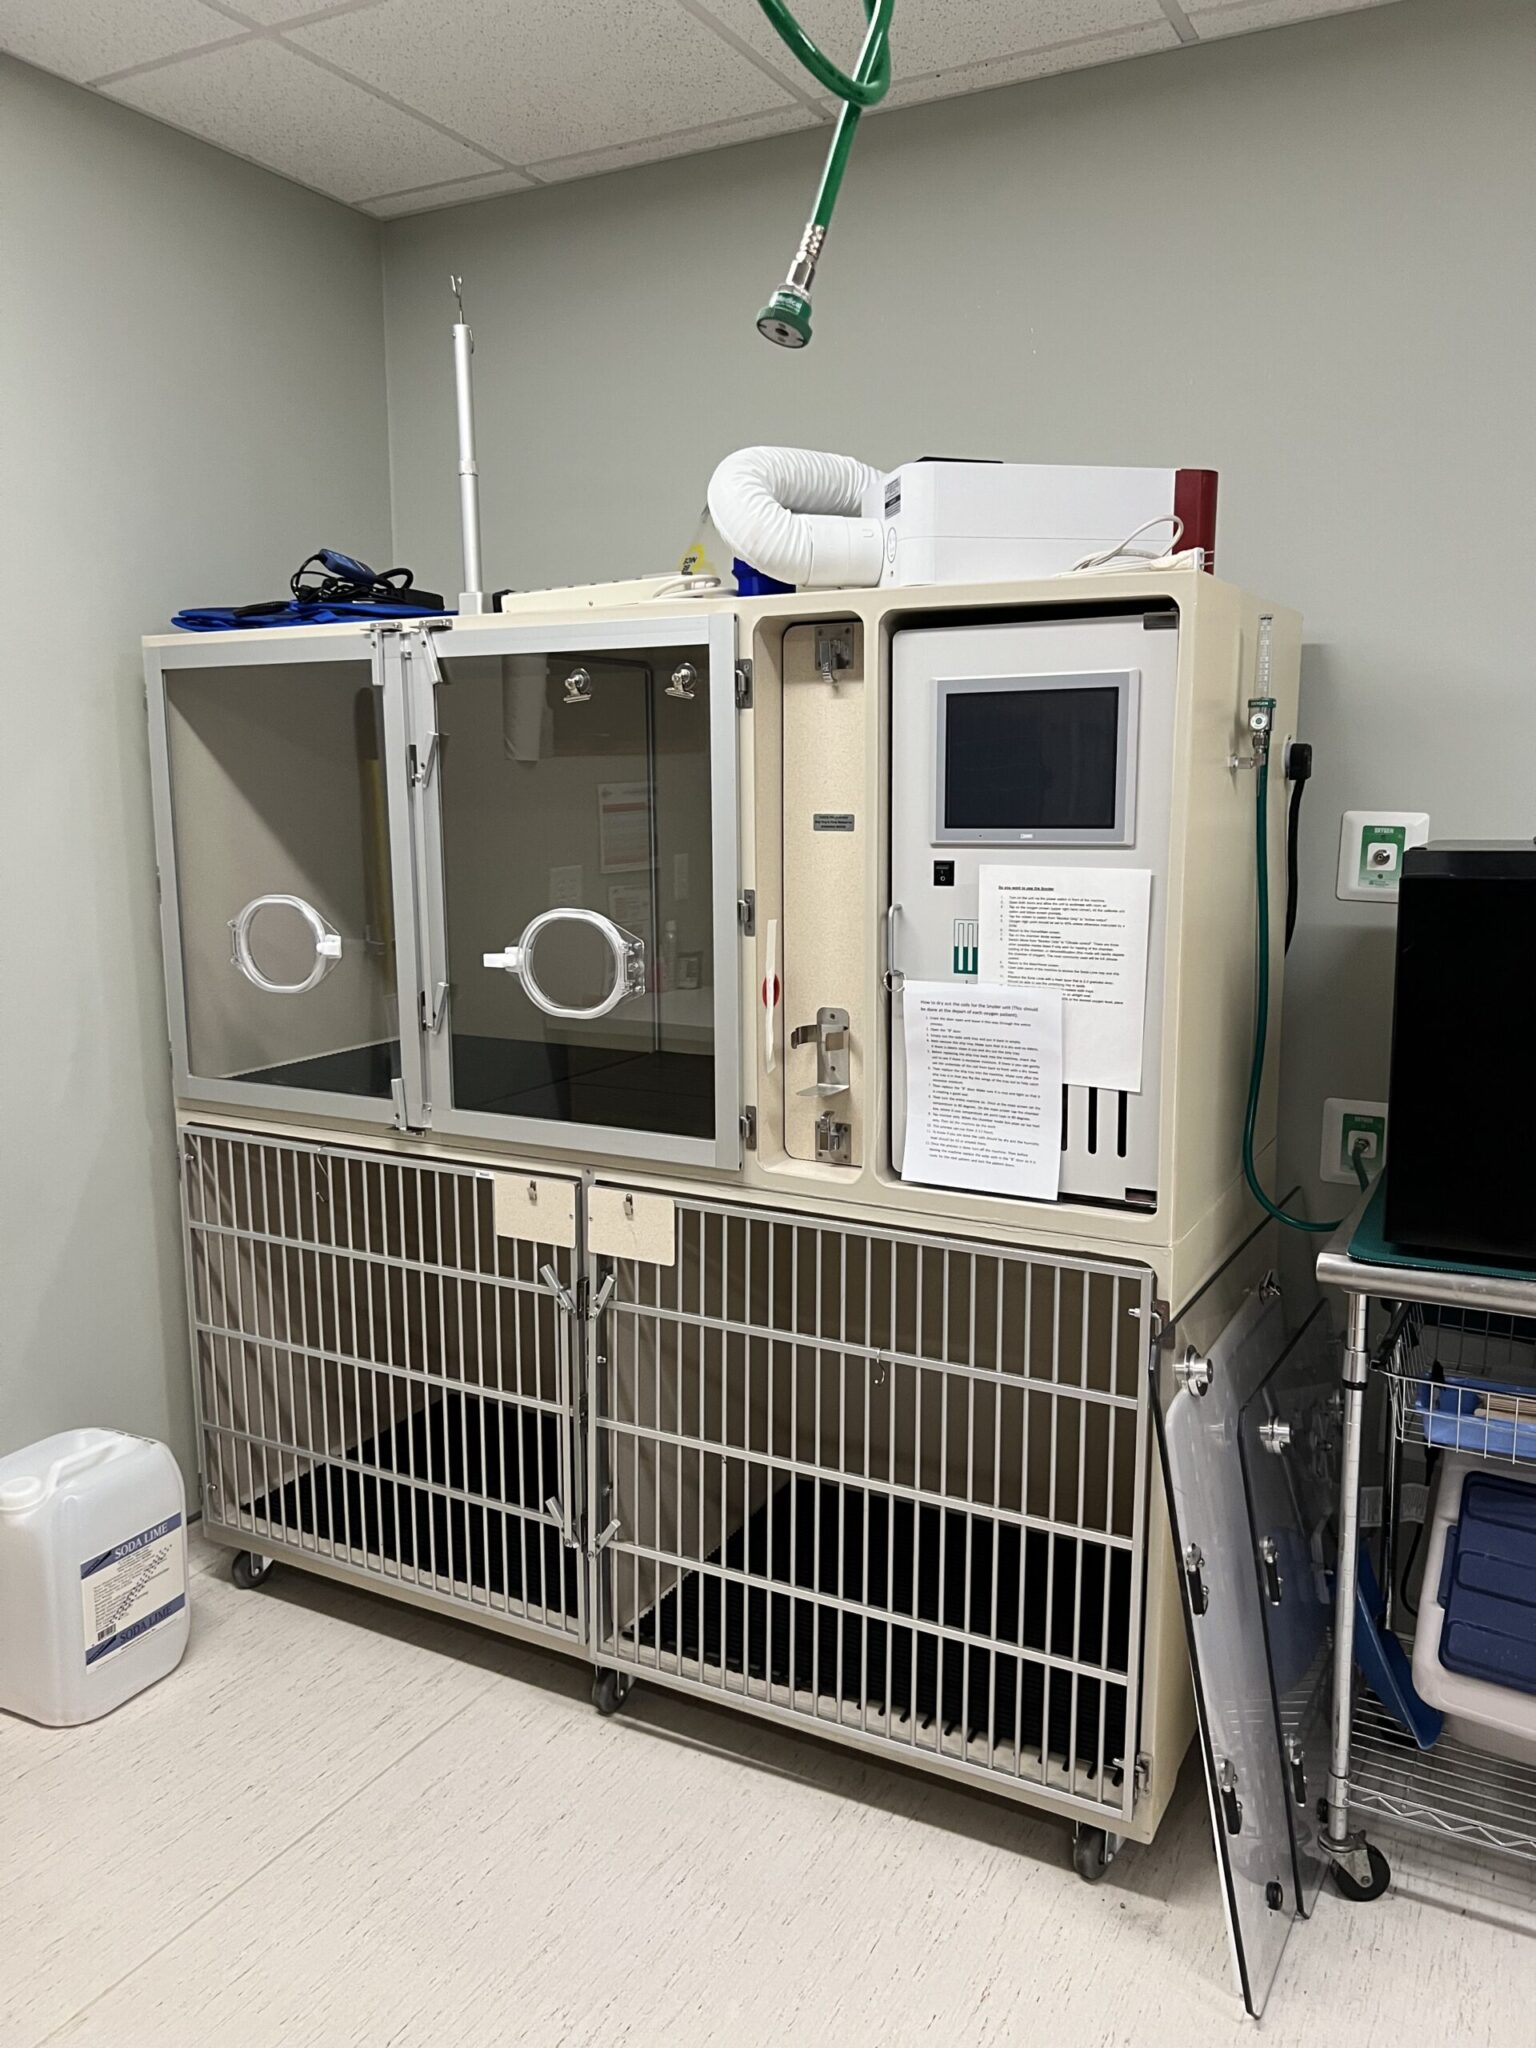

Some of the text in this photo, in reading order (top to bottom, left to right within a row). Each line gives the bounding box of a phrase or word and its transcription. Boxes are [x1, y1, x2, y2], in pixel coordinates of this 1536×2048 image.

[115, 1522, 168, 1560] SODA LIME
[120, 1620, 147, 1642] SODA
[149, 1606, 173, 1628] LIME
